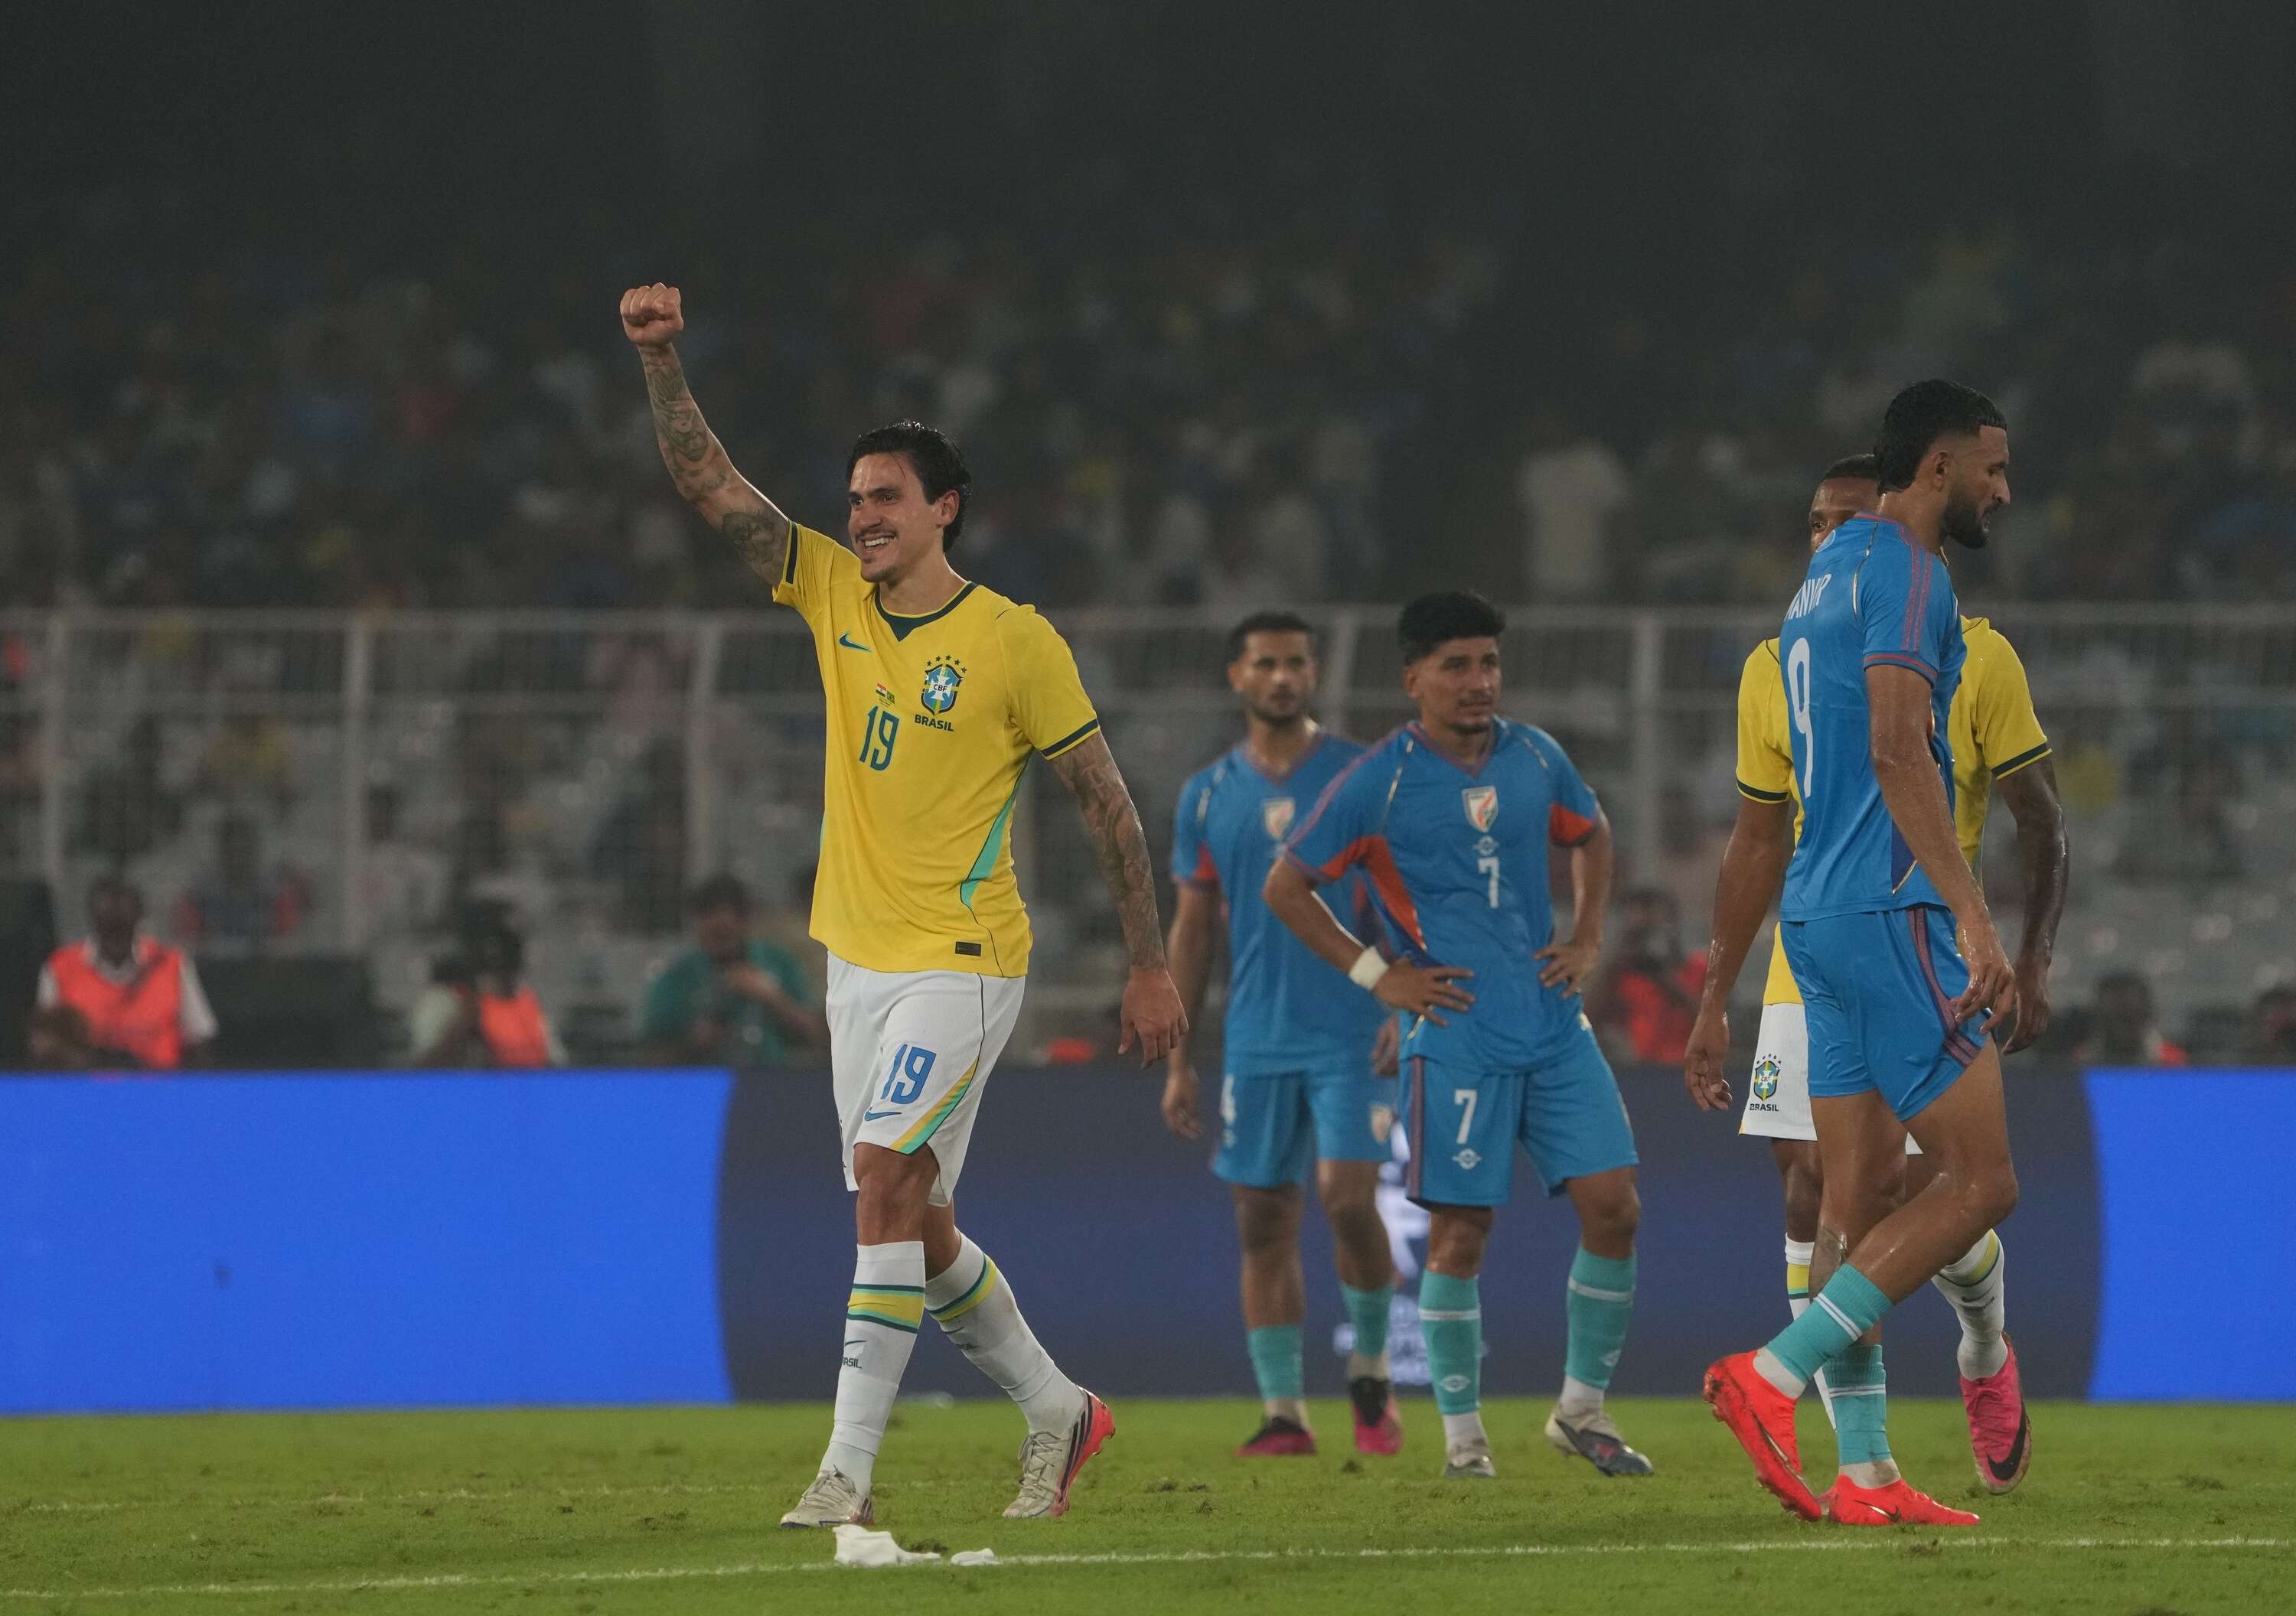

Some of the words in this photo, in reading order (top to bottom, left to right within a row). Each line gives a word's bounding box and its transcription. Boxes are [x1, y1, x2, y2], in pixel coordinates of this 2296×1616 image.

[933, 683, 948, 692] CBF
[859, 705, 900, 771] 19
[915, 714, 954, 732] BRASIL
[1787, 637, 1814, 799] 9
[1478, 856, 1500, 909] 7
[880, 1044, 937, 1105] 19
[1454, 1089, 1478, 1145] 7
[1750, 1103, 1779, 1112] BRASIL
